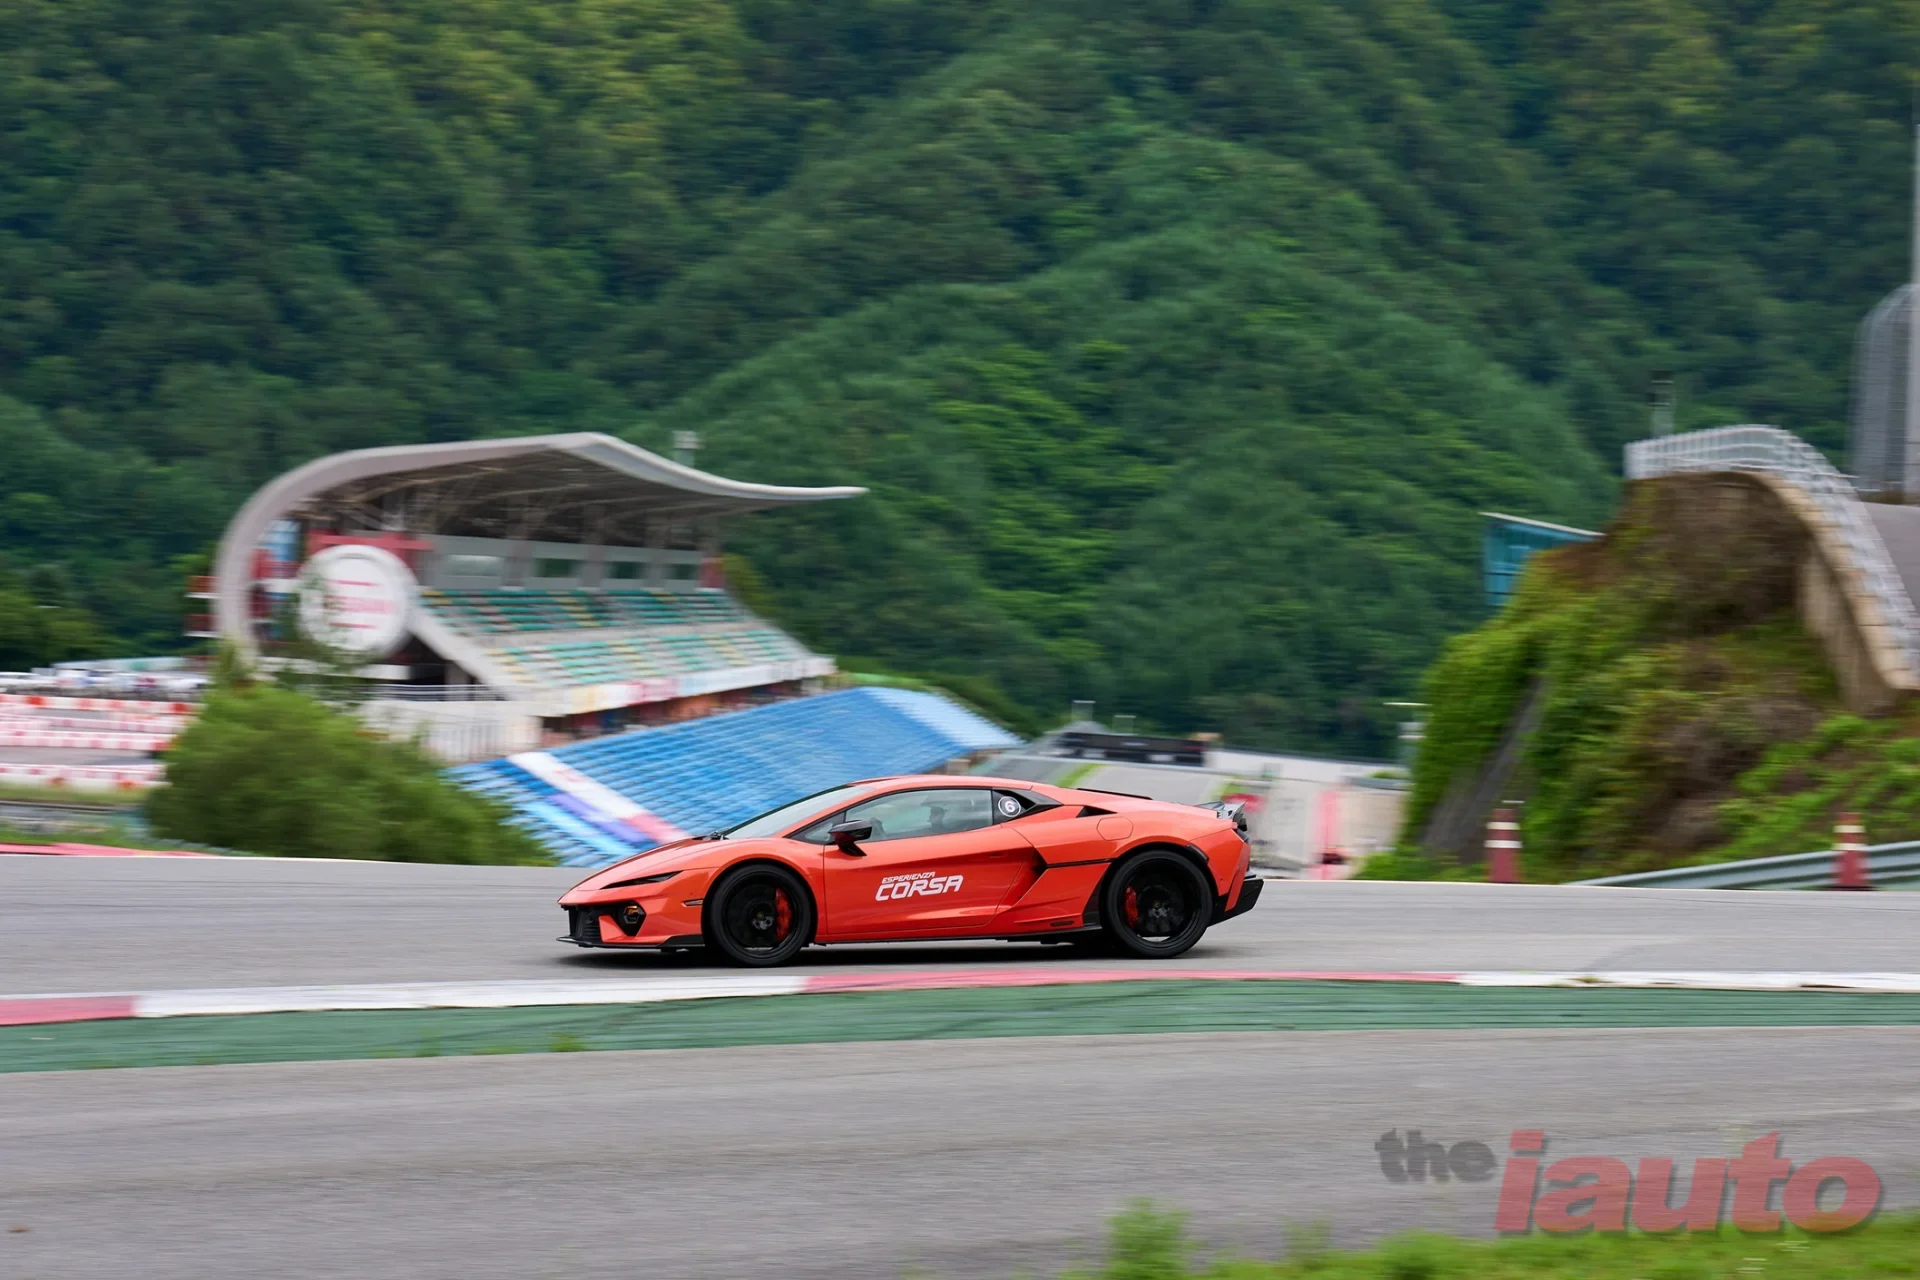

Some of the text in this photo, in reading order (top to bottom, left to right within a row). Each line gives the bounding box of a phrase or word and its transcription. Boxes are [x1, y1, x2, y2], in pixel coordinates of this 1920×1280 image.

[1004, 800, 1016, 813] 6
[881, 871, 936, 884] ESPERIENZA
[875, 875, 964, 902] CORSA
